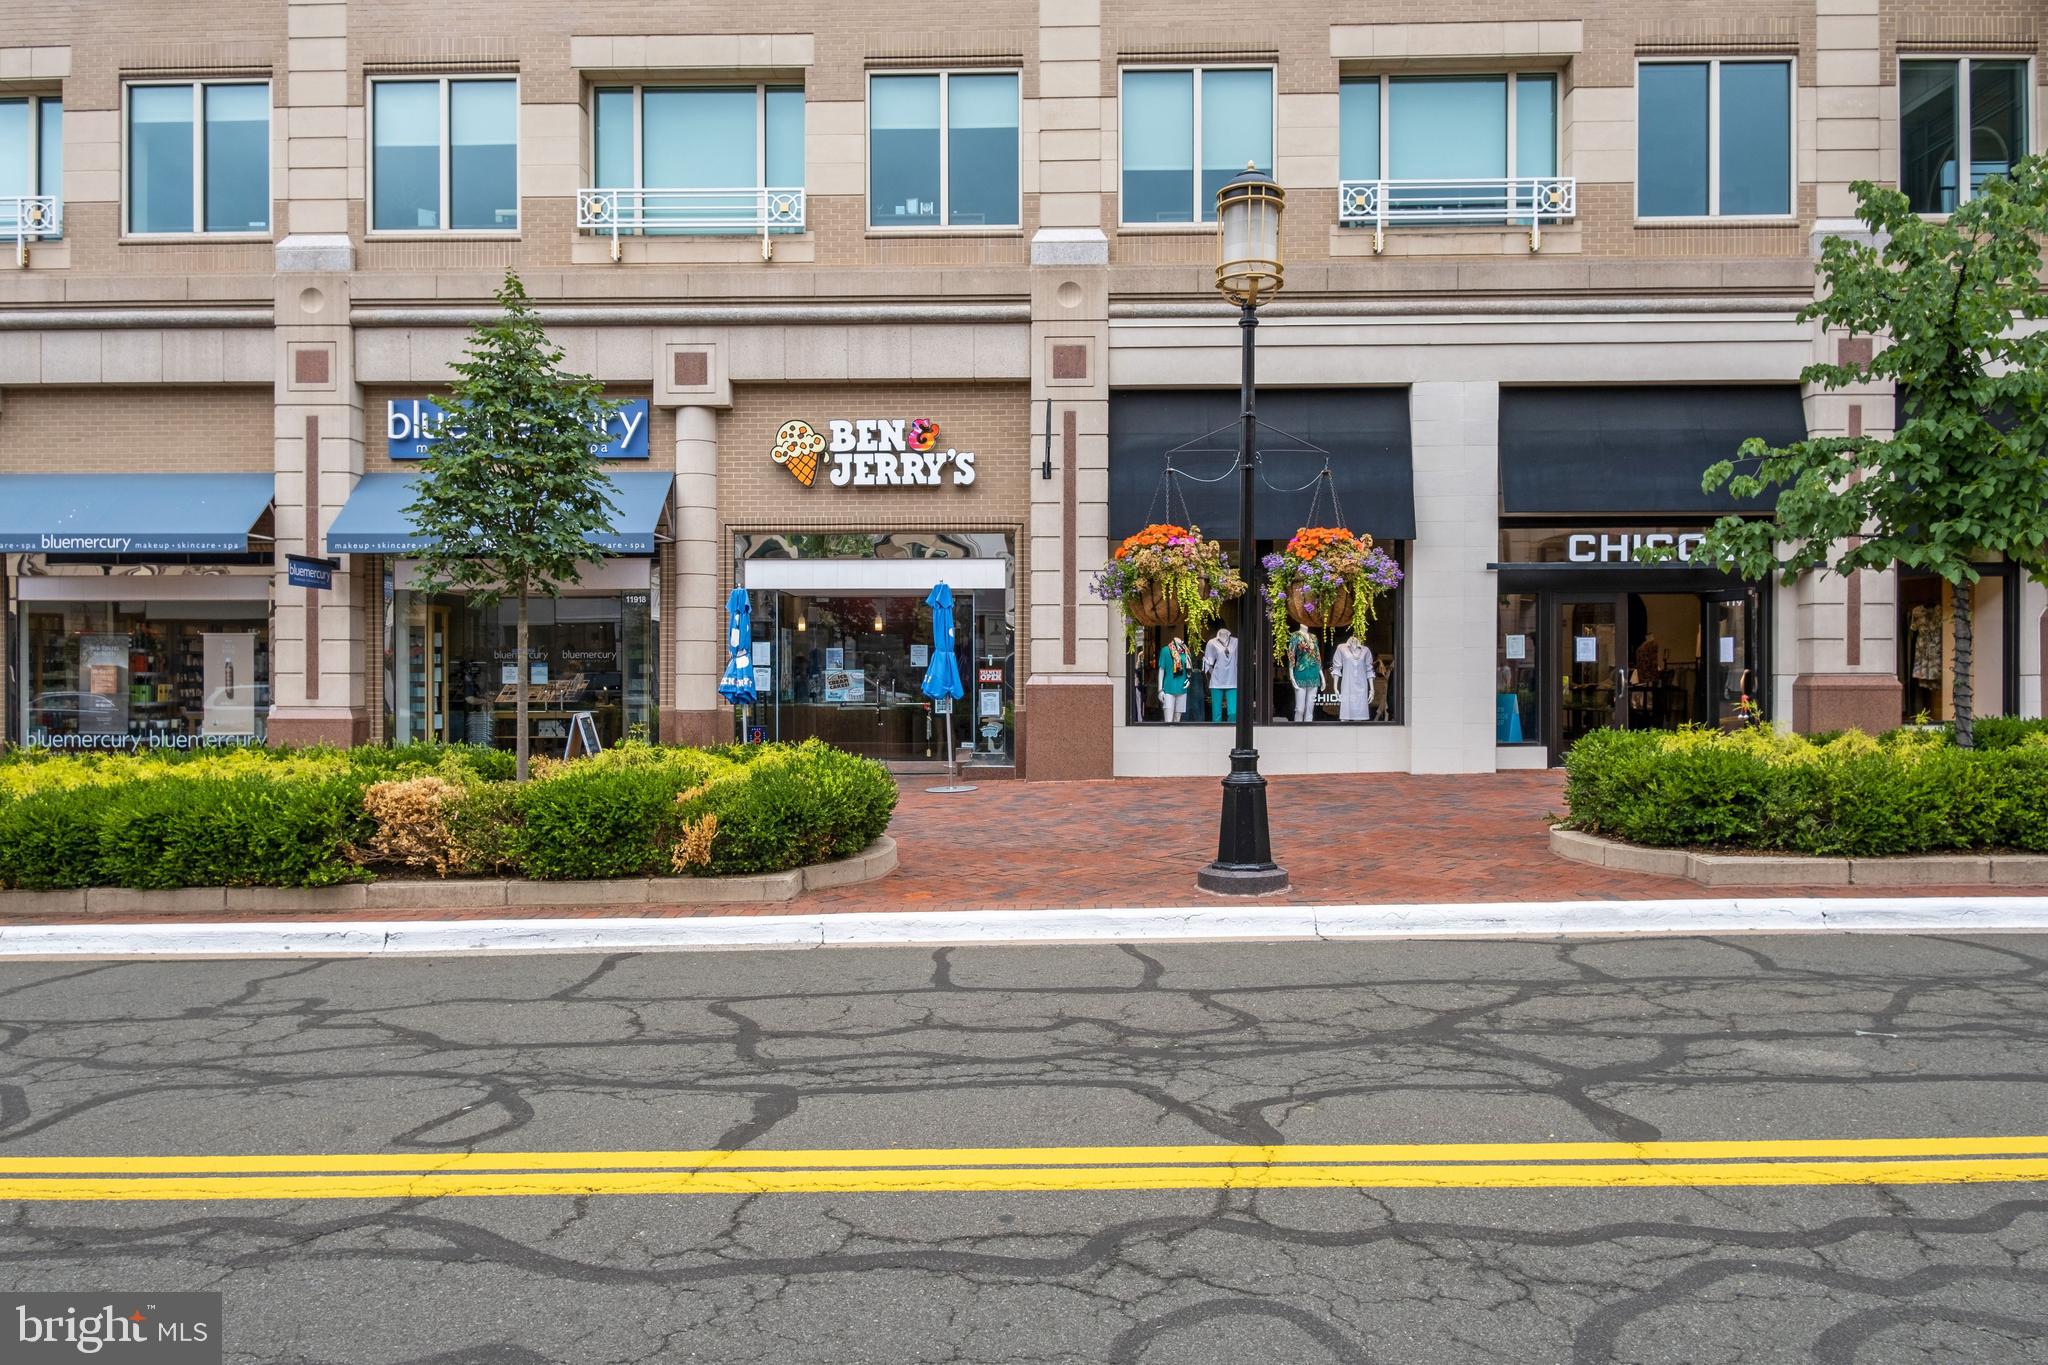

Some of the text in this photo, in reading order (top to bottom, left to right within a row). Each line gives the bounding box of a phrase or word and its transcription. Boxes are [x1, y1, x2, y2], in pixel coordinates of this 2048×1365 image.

[829, 418, 940, 451] BEN &
[829, 448, 976, 487] JERRY'S
[41, 534, 131, 551] bluemercury
[134, 542, 170, 550] makeup
[177, 541, 216, 549] skincare
[334, 542, 370, 550] makeup
[377, 541, 416, 549] skincare
[289, 562, 331, 583] bluemercury
[562, 650, 617, 661] bluemercury
[980, 673, 1002, 681] OPEN
[26, 729, 267, 752] bluemercury bluemercury
